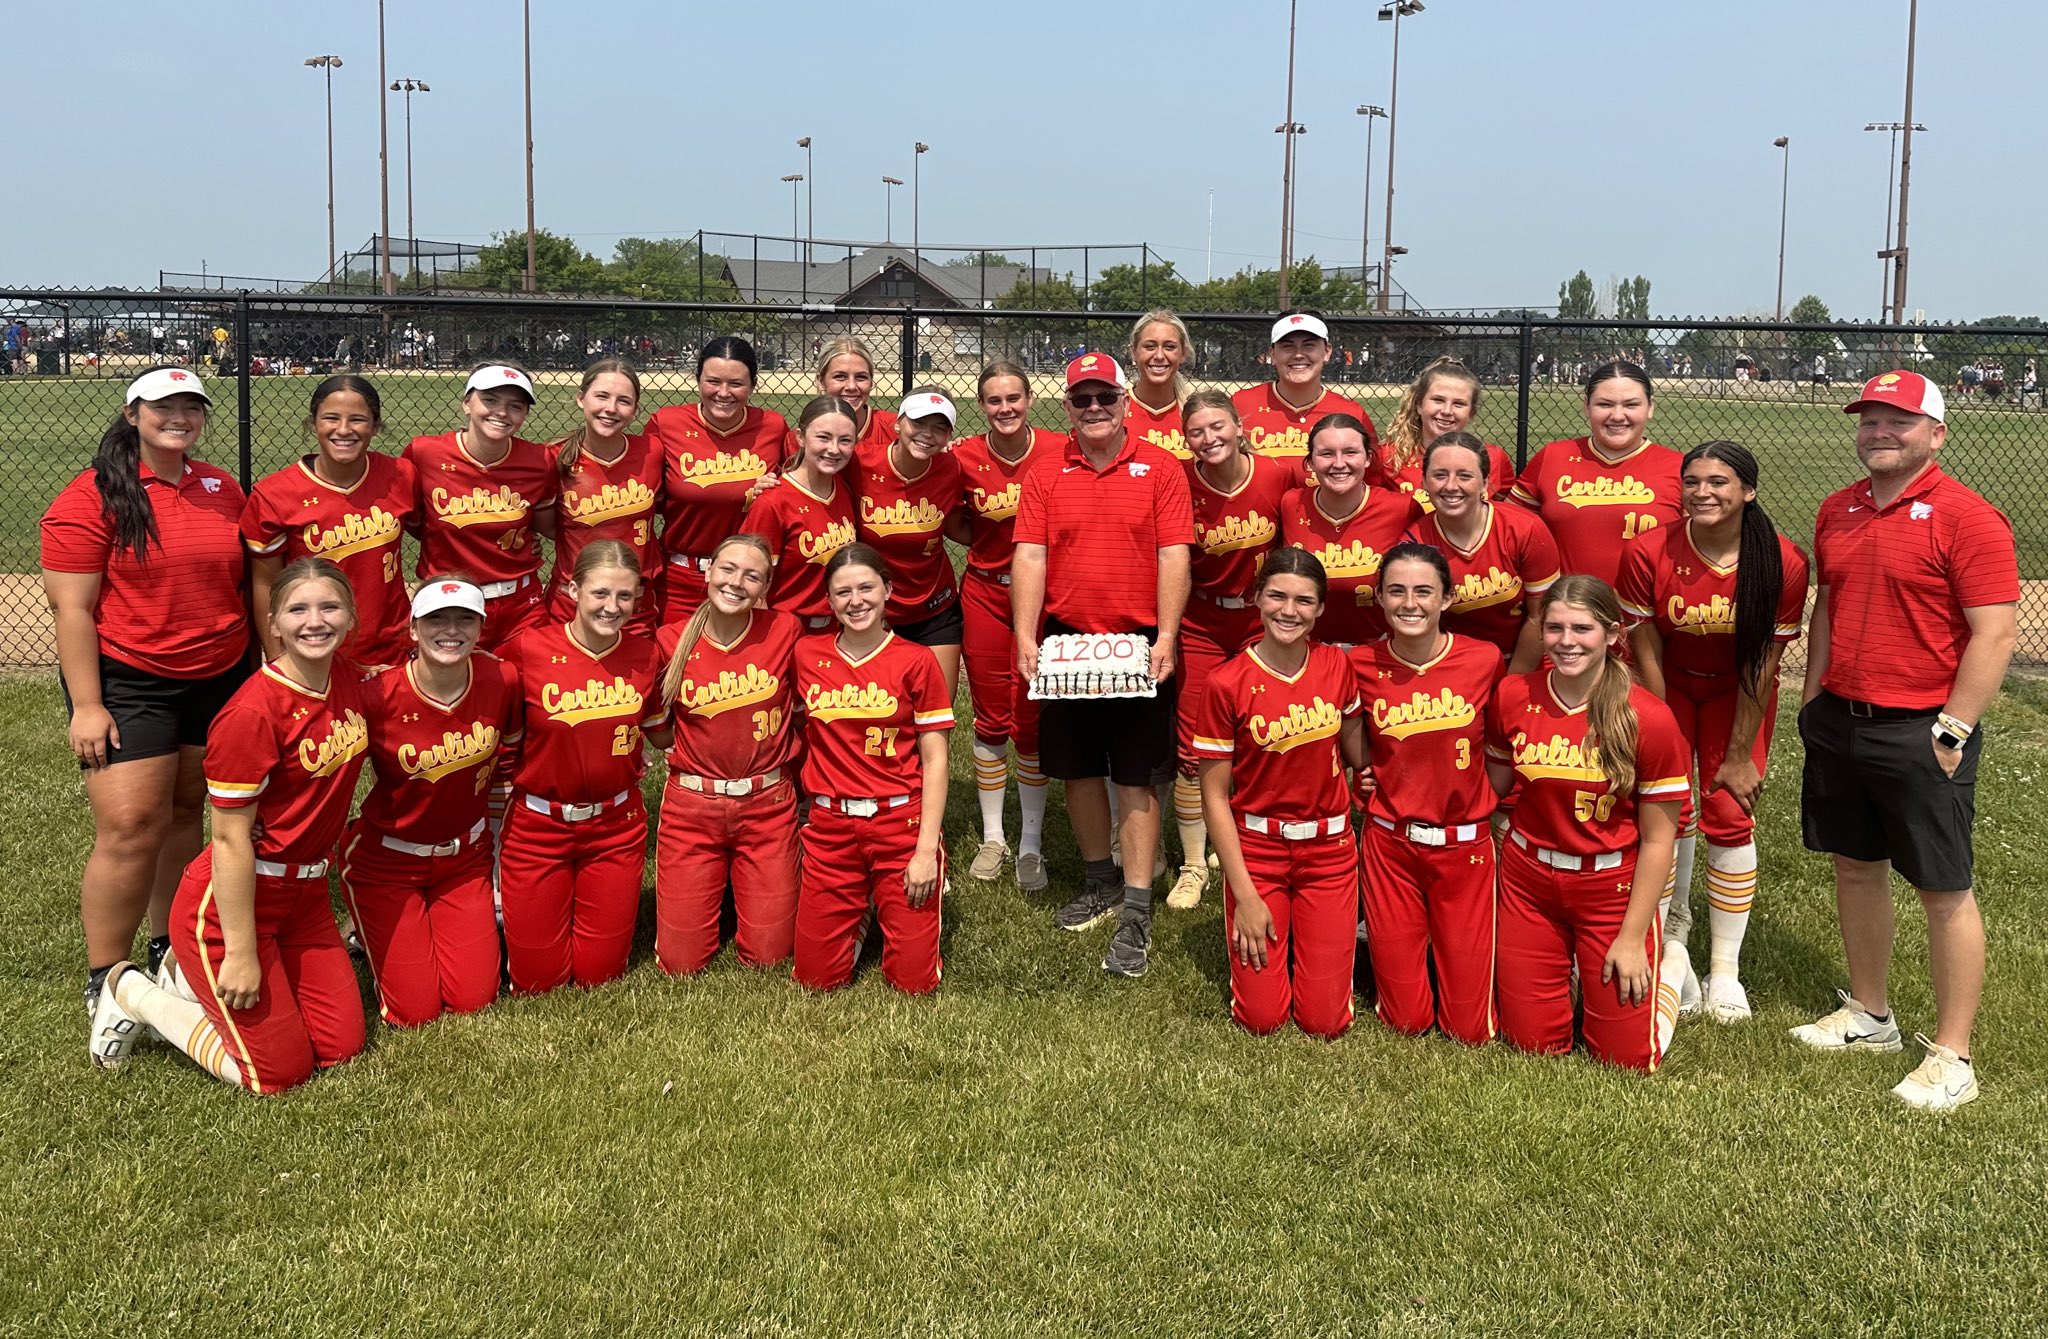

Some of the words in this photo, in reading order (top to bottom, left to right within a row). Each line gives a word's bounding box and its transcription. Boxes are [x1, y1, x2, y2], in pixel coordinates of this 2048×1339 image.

[1251, 427, 1315, 451] Carlis
[680, 449, 762, 477] Carlisle
[432, 485, 522, 515] Carlisle
[564, 479, 650, 516] Carlisle
[973, 482, 1021, 512] Carli
[1557, 475, 1648, 498] Carlisle
[861, 496, 939, 524] Carlisle
[304, 505, 397, 553] Carlisle
[1195, 510, 1271, 548] Carlisle
[1293, 540, 1376, 568] rlisle
[1668, 594, 1736, 626] Carli
[1051, 639, 1134, 662] 1200
[542, 676, 639, 714] Carlisle
[681, 663, 772, 708] Carlisle
[806, 681, 892, 710] Carlisle
[752, 706, 782, 741] 30
[1250, 696, 1339, 746] Carlisle
[1373, 687, 1467, 728] Carlisle
[299, 708, 367, 772] Carlisle
[398, 721, 498, 774] Carlisle
[611, 724, 640, 756] 23
[864, 726, 899, 757] 27
[1456, 738, 1470, 770] 3
[1575, 789, 1616, 822] 50
